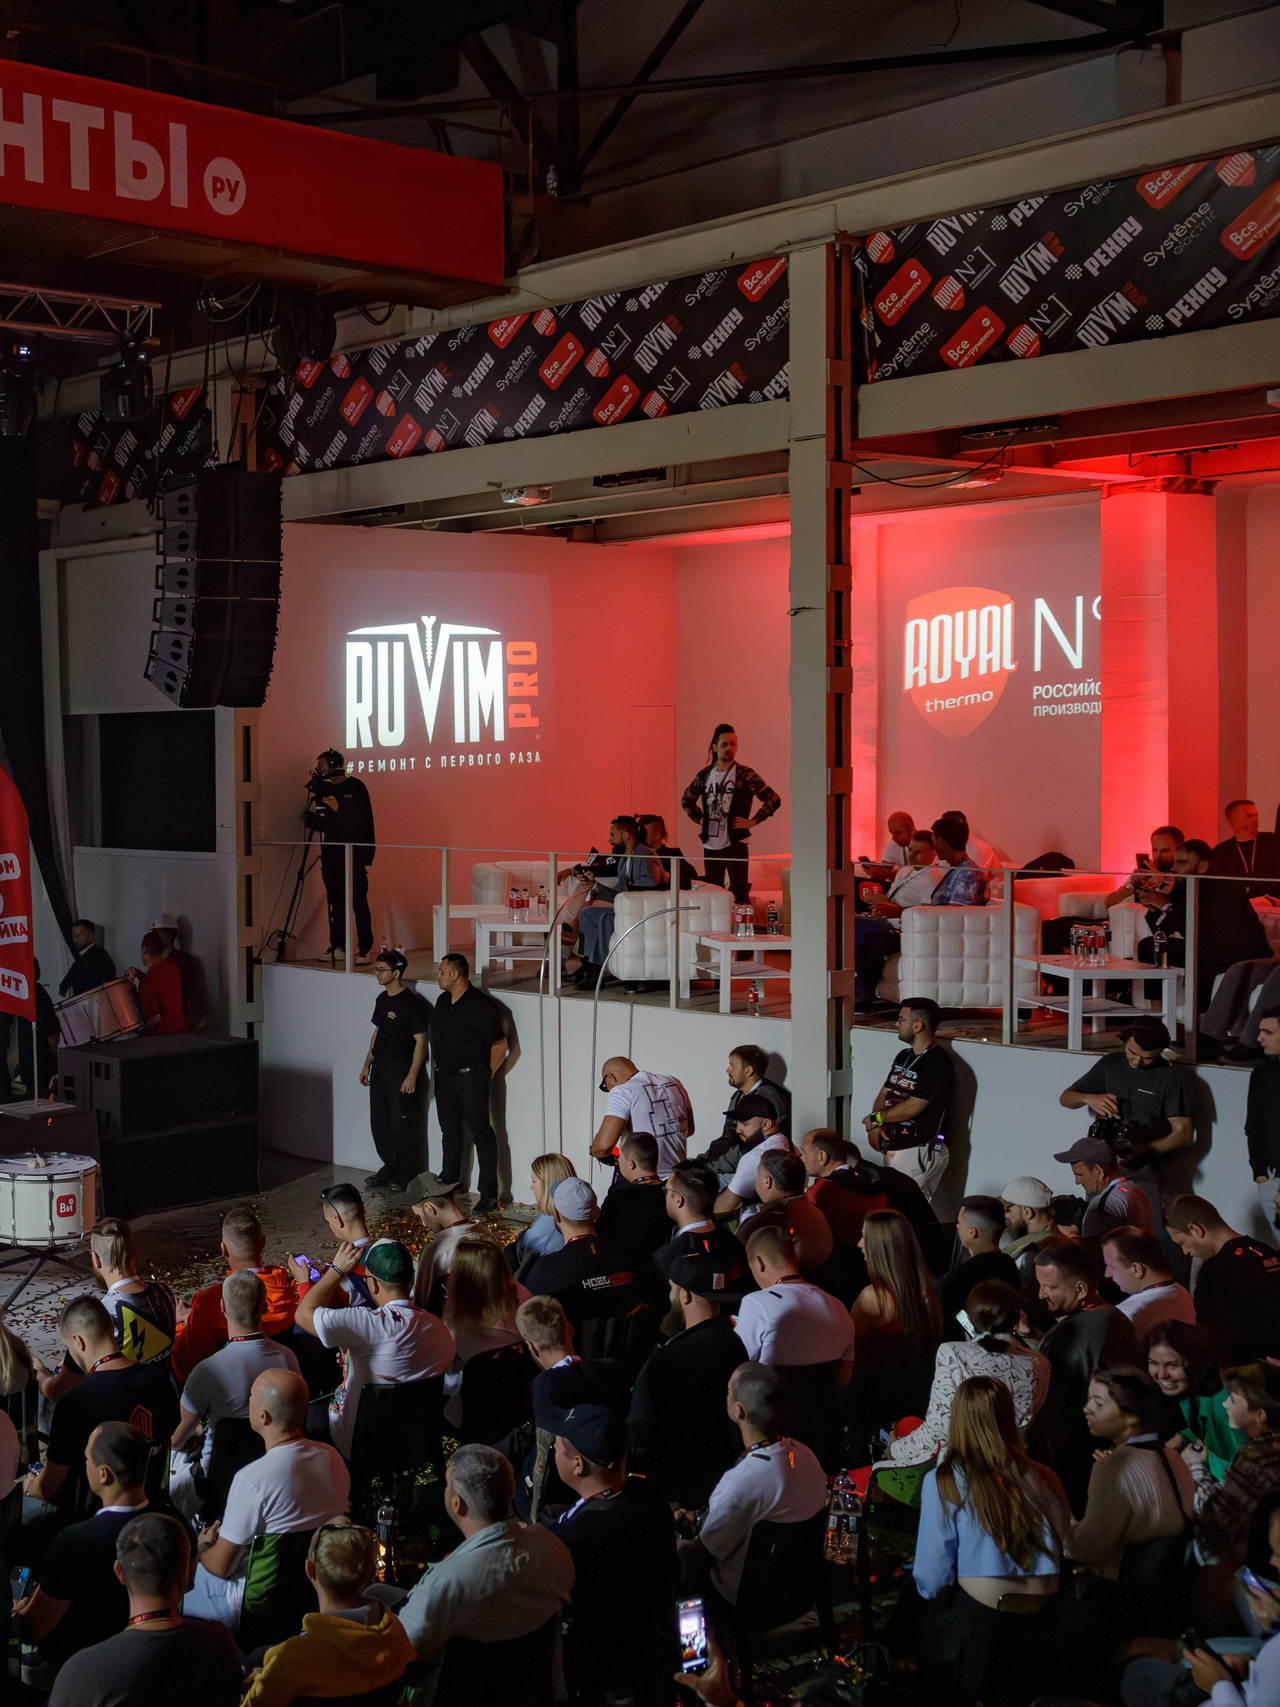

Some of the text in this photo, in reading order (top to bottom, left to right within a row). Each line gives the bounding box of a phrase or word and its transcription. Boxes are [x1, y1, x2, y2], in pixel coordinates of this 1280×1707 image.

[1229, 219, 1259, 246] Все
[742, 268, 764, 291] Все
[877, 291, 899, 314] Все
[947, 339, 971, 362] Все
[542, 360, 560, 380] Все
[904, 603, 1016, 690] ROYAL
[346, 620, 505, 749] RUVIM
[925, 690, 994, 713] thermo
[346, 757, 416, 774] #РЕМОНТ
[440, 753, 501, 768] ПЕРВОГО
[510, 751, 541, 763] РАЗА
